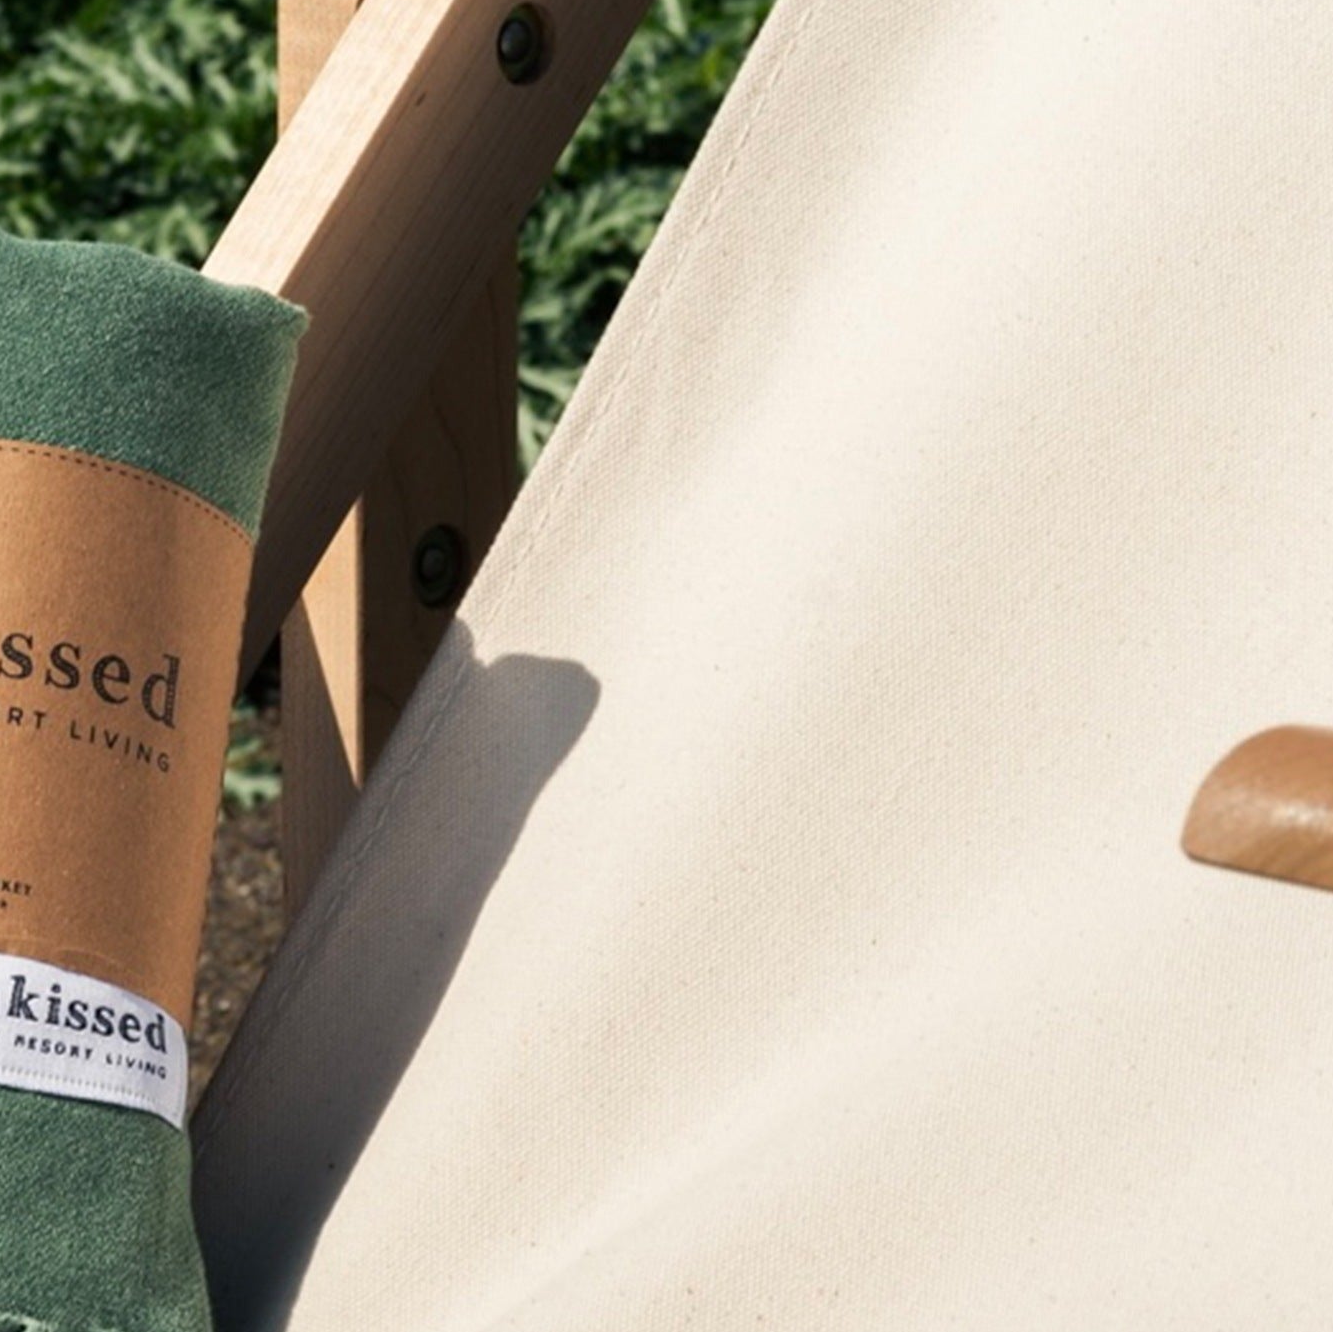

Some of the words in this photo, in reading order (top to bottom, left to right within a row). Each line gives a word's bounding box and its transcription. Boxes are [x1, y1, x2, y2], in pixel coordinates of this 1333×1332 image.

[68, 720, 172, 774] LIVING
[14, 1034, 94, 1061] RESORT
[105, 1052, 168, 1080] LIVING
